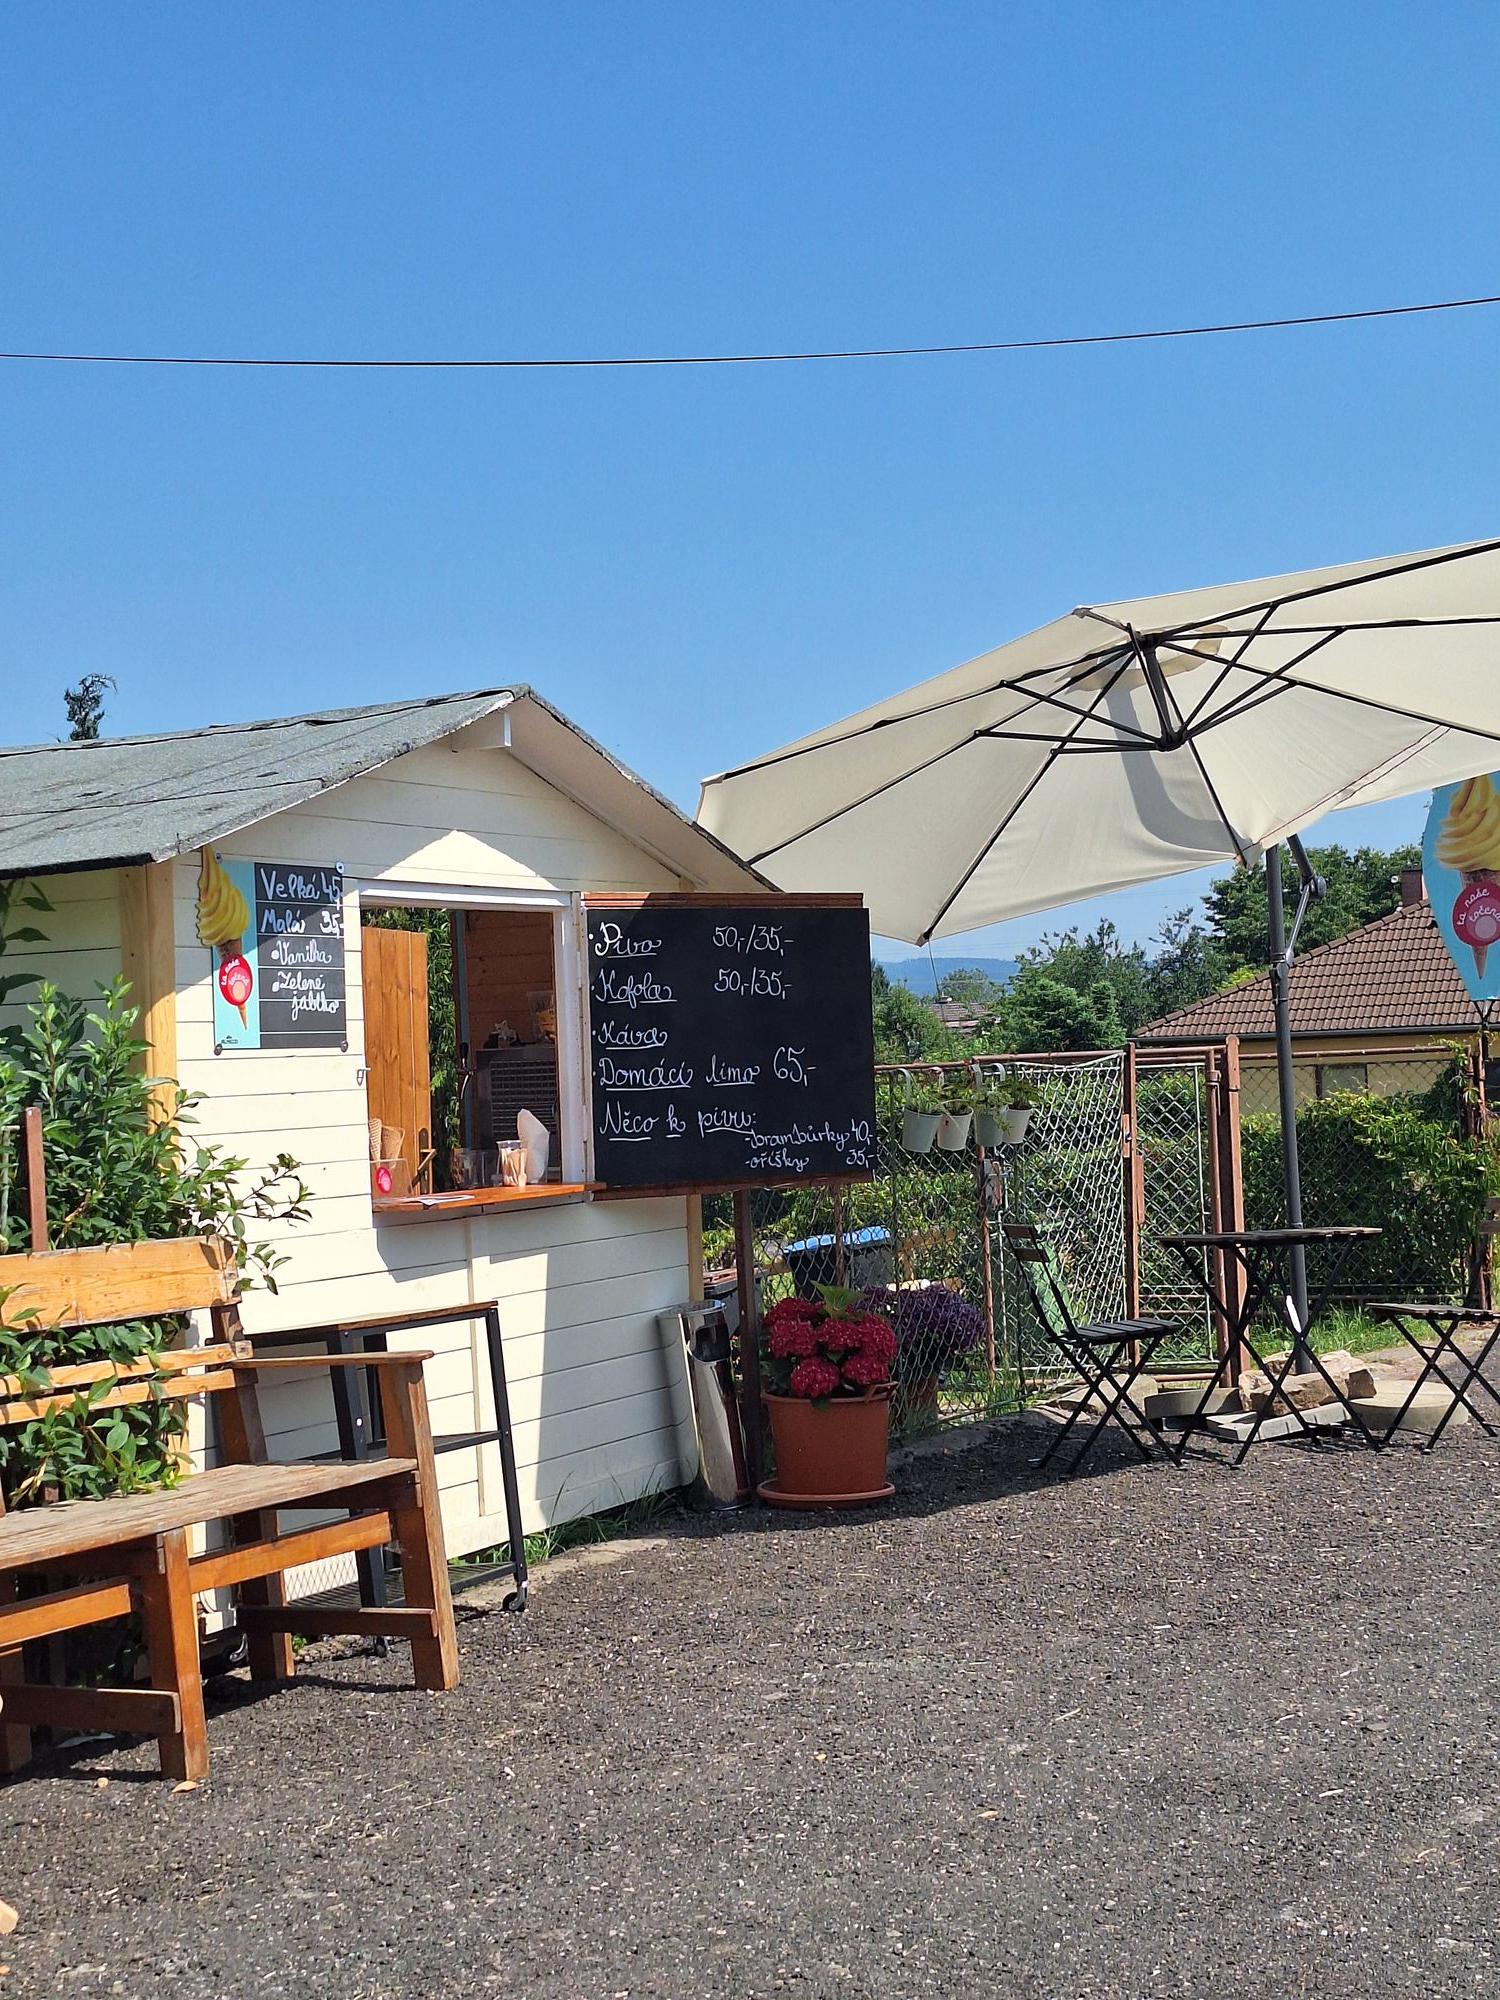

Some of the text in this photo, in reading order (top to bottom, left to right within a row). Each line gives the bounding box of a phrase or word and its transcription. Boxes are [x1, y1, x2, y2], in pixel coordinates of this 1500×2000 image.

[260, 867, 320, 900] Velká
[260, 909, 306, 934] Malá
[594, 921, 795, 957] Pivo 50,-/35,-
[277, 970, 326, 991] Zelené
[595, 966, 793, 1010] Kofola 50,-/35,-
[597, 1020, 668, 1046] Káva
[599, 1046, 817, 1088] Domácí limo 65,-
[599, 1100, 660, 1135] Něco
[665, 1103, 687, 1132] k
[851, 1118, 874, 1146] 40,-
[845, 1147, 875, 1169] 35,-
